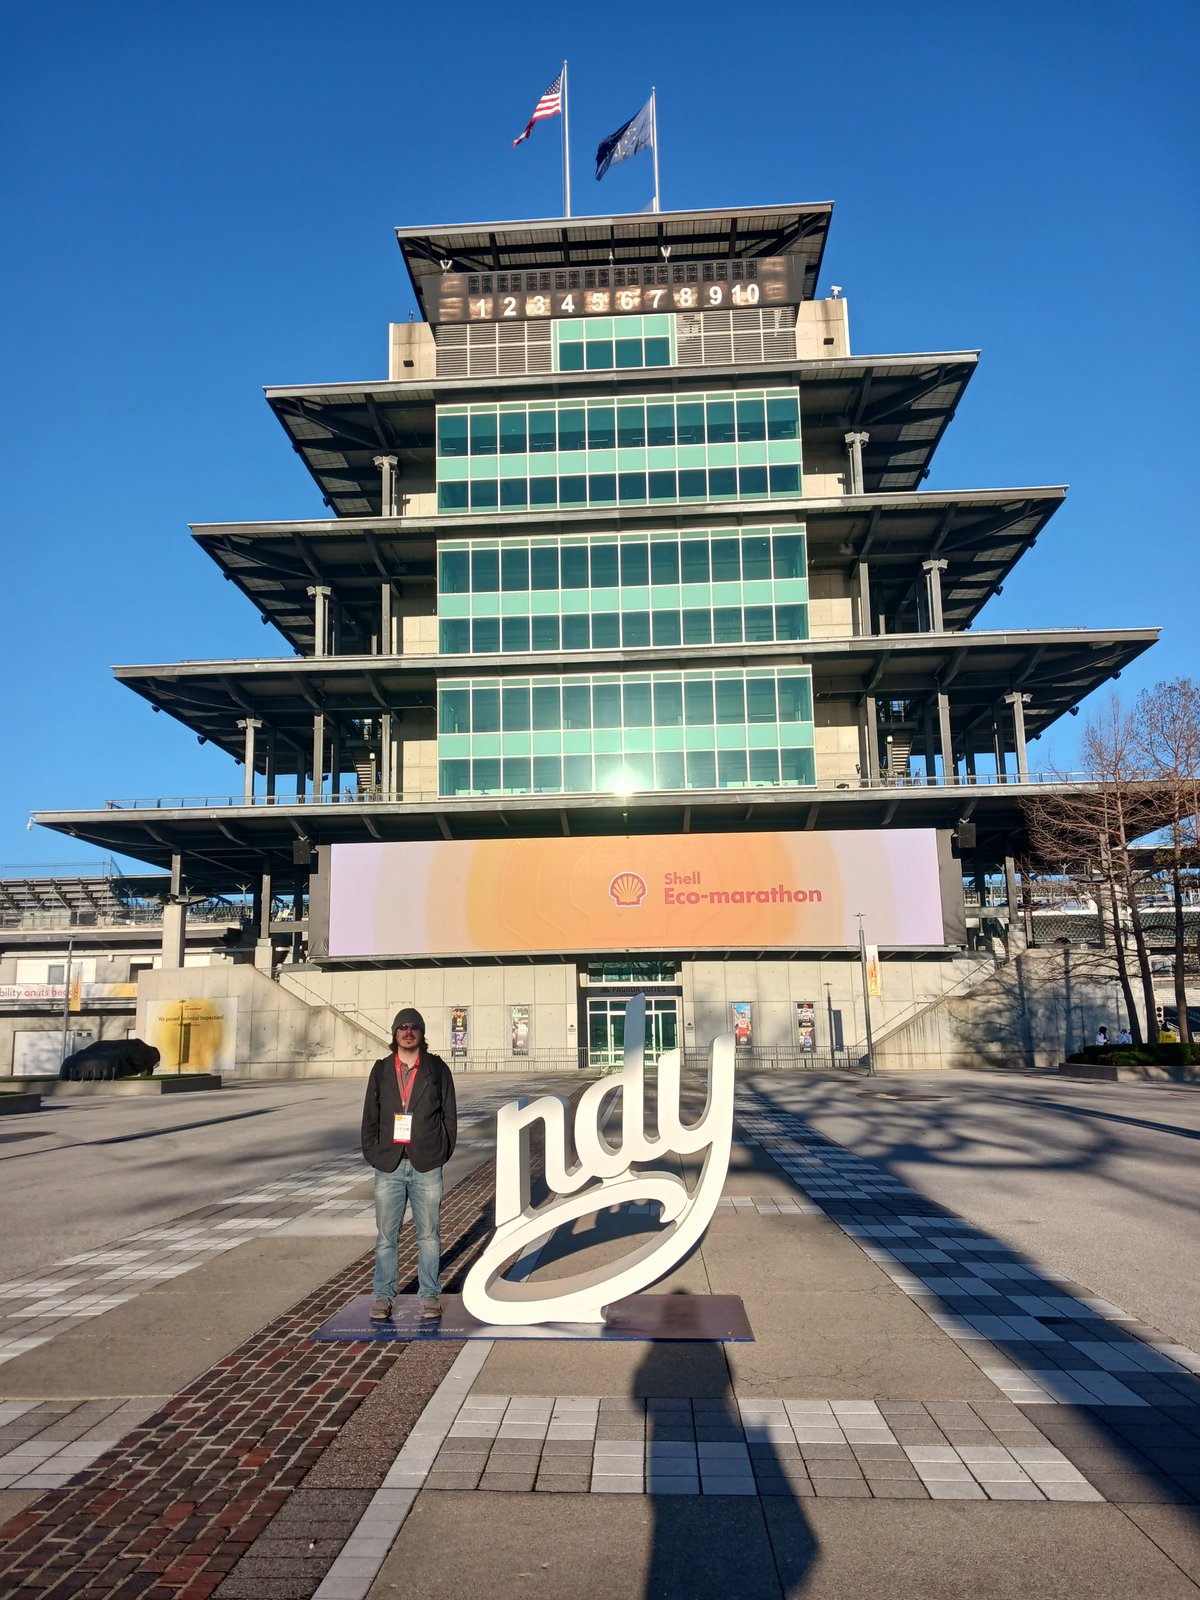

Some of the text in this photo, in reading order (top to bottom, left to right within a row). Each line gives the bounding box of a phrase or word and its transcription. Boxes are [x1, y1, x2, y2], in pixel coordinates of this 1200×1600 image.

[476, 284, 759, 318] 1 2 3 4 5 6 7 8 9 10
[664, 871, 701, 885] Shell
[664, 884, 822, 905] Eco-marathon
[24, 989, 36, 997] on
[38, 987, 49, 997] its
[641, 985, 667, 993] SUITES
